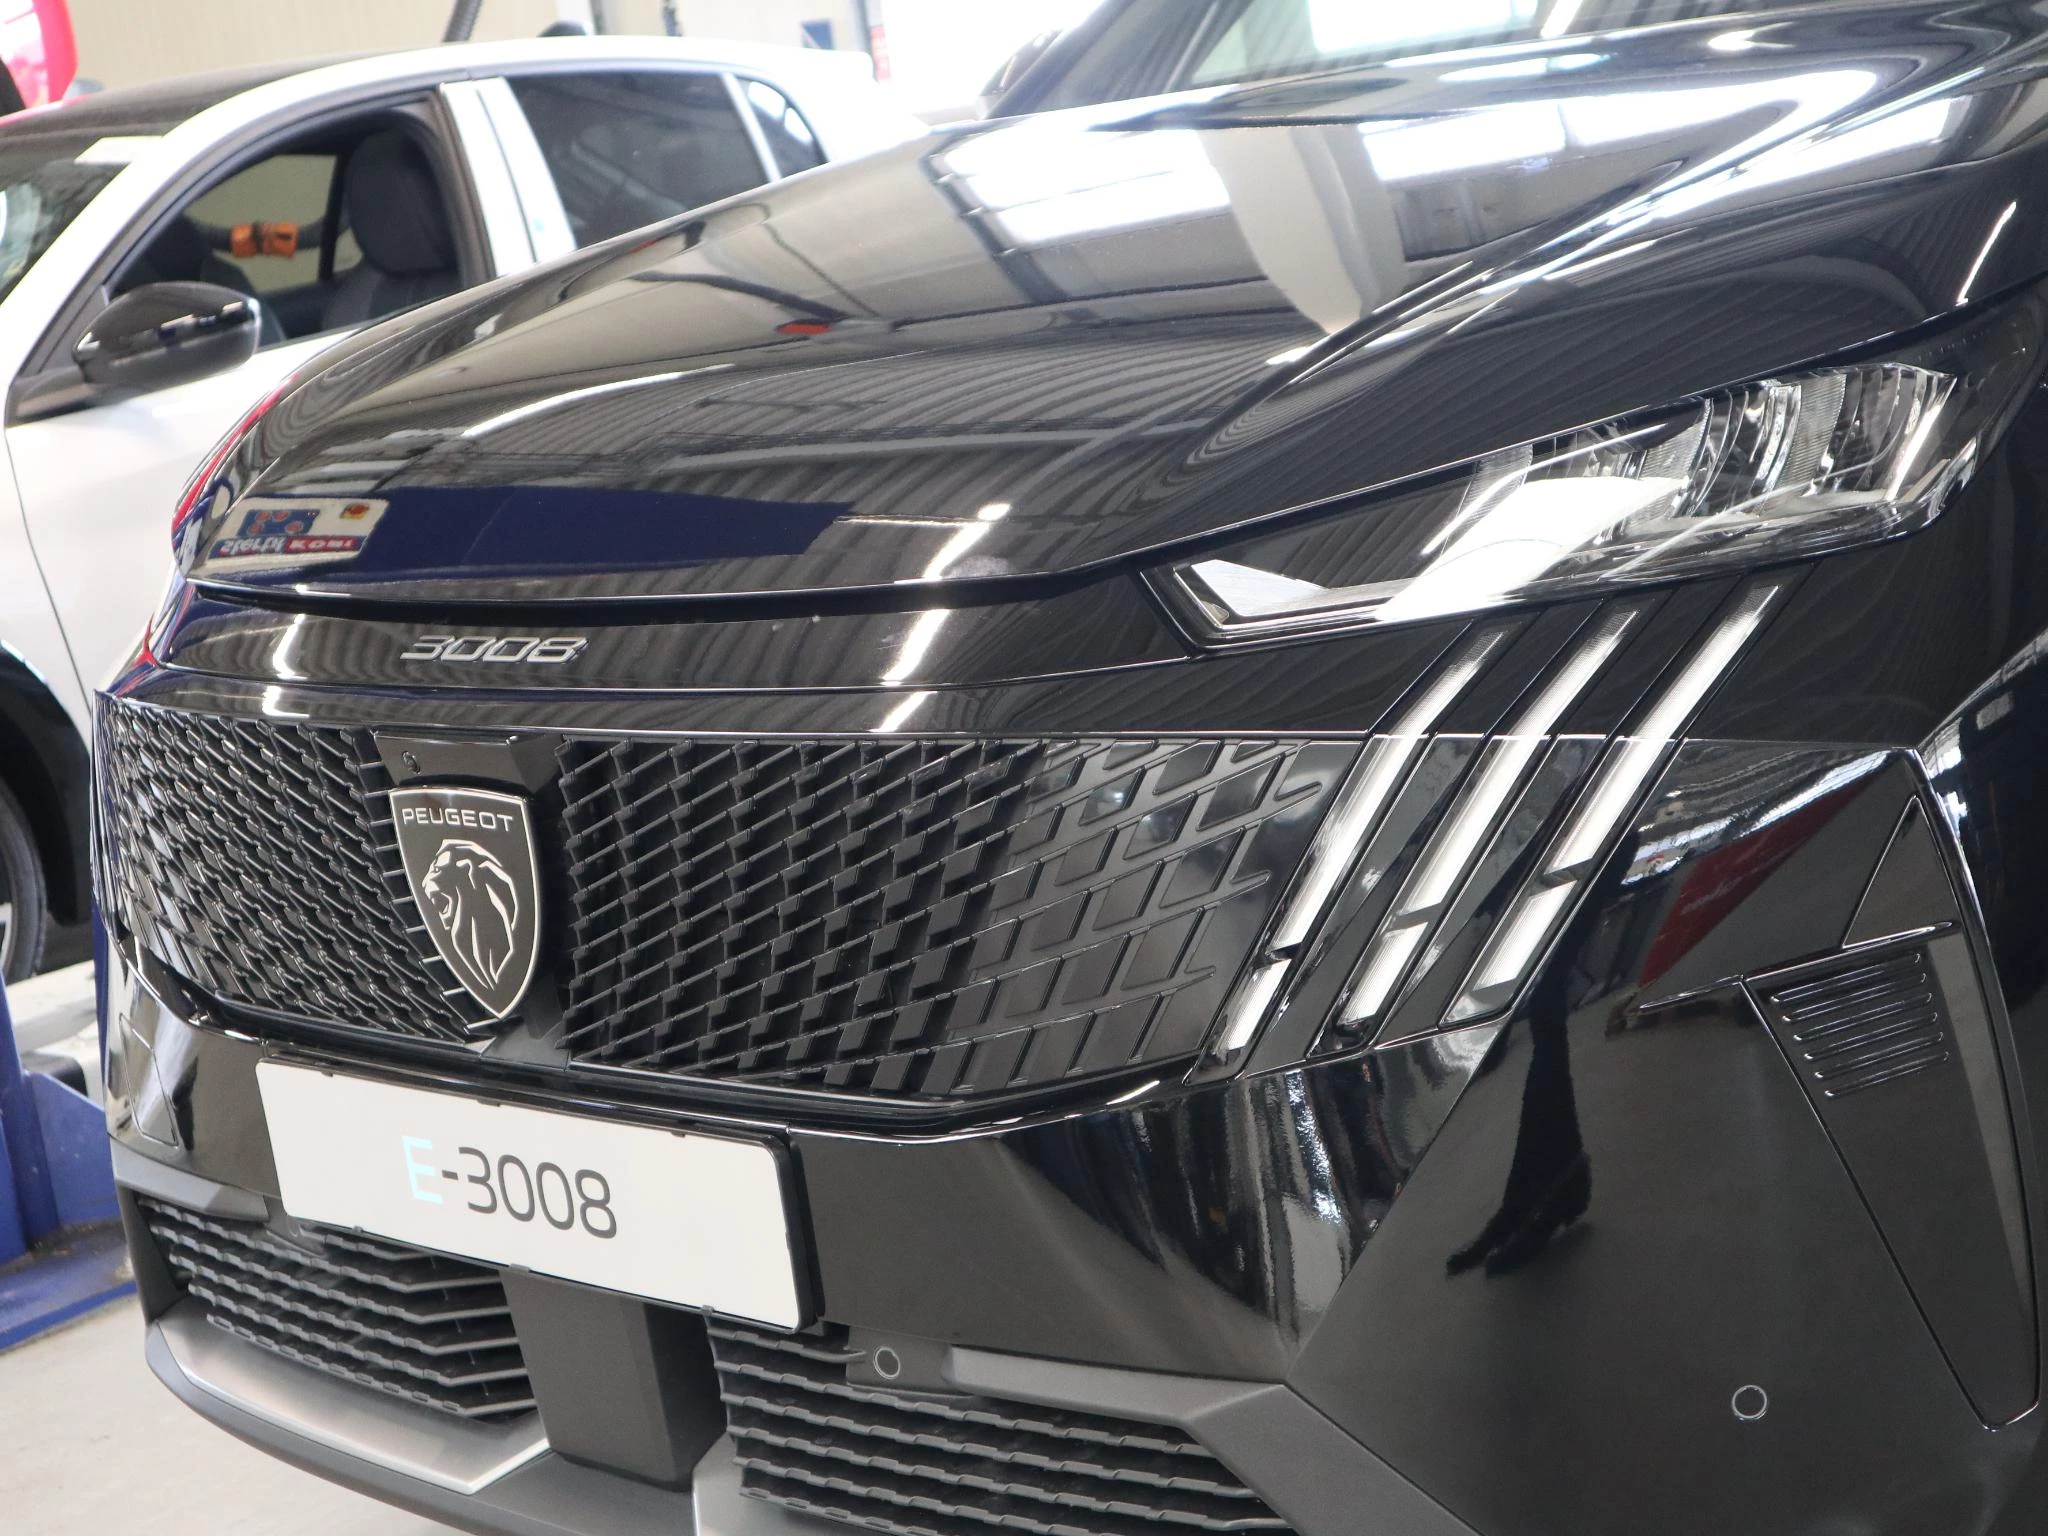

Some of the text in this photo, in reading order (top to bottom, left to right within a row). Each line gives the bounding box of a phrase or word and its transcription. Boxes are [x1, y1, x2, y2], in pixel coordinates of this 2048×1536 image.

[400, 635, 588, 664] 3008
[402, 807, 513, 832] PEUGEOT
[402, 1135, 617, 1239] E-3008
